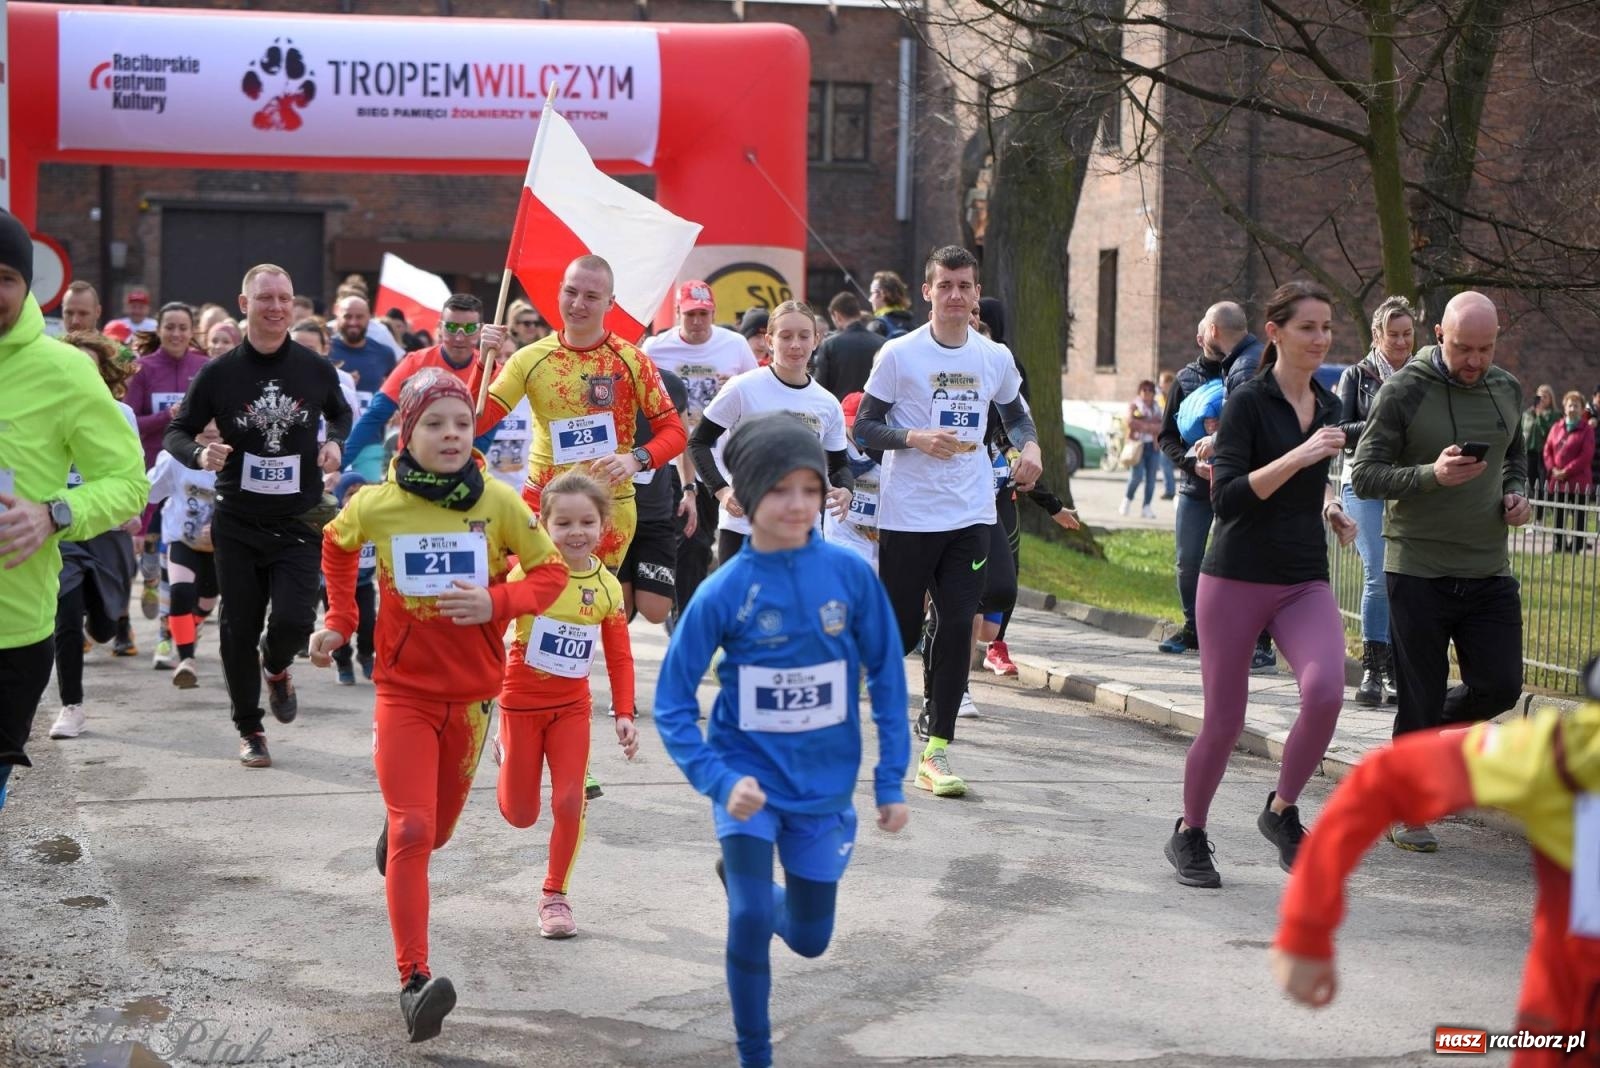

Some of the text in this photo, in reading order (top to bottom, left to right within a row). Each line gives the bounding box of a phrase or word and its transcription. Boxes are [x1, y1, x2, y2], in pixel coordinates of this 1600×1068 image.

[112, 53, 200, 74] Raciborskie
[112, 92, 167, 115] Kultury
[357, 106, 389, 118] BIEG
[393, 107, 448, 119] PAMIĘCI
[529, 110, 608, 121] WĘTYCH
[503, 420, 518, 430] 99
[952, 412, 969, 426] 36
[573, 429, 594, 445] 28
[259, 468, 286, 481] 138
[424, 552, 451, 574] 21
[554, 638, 586, 658] 100
[771, 687, 819, 710] 123
